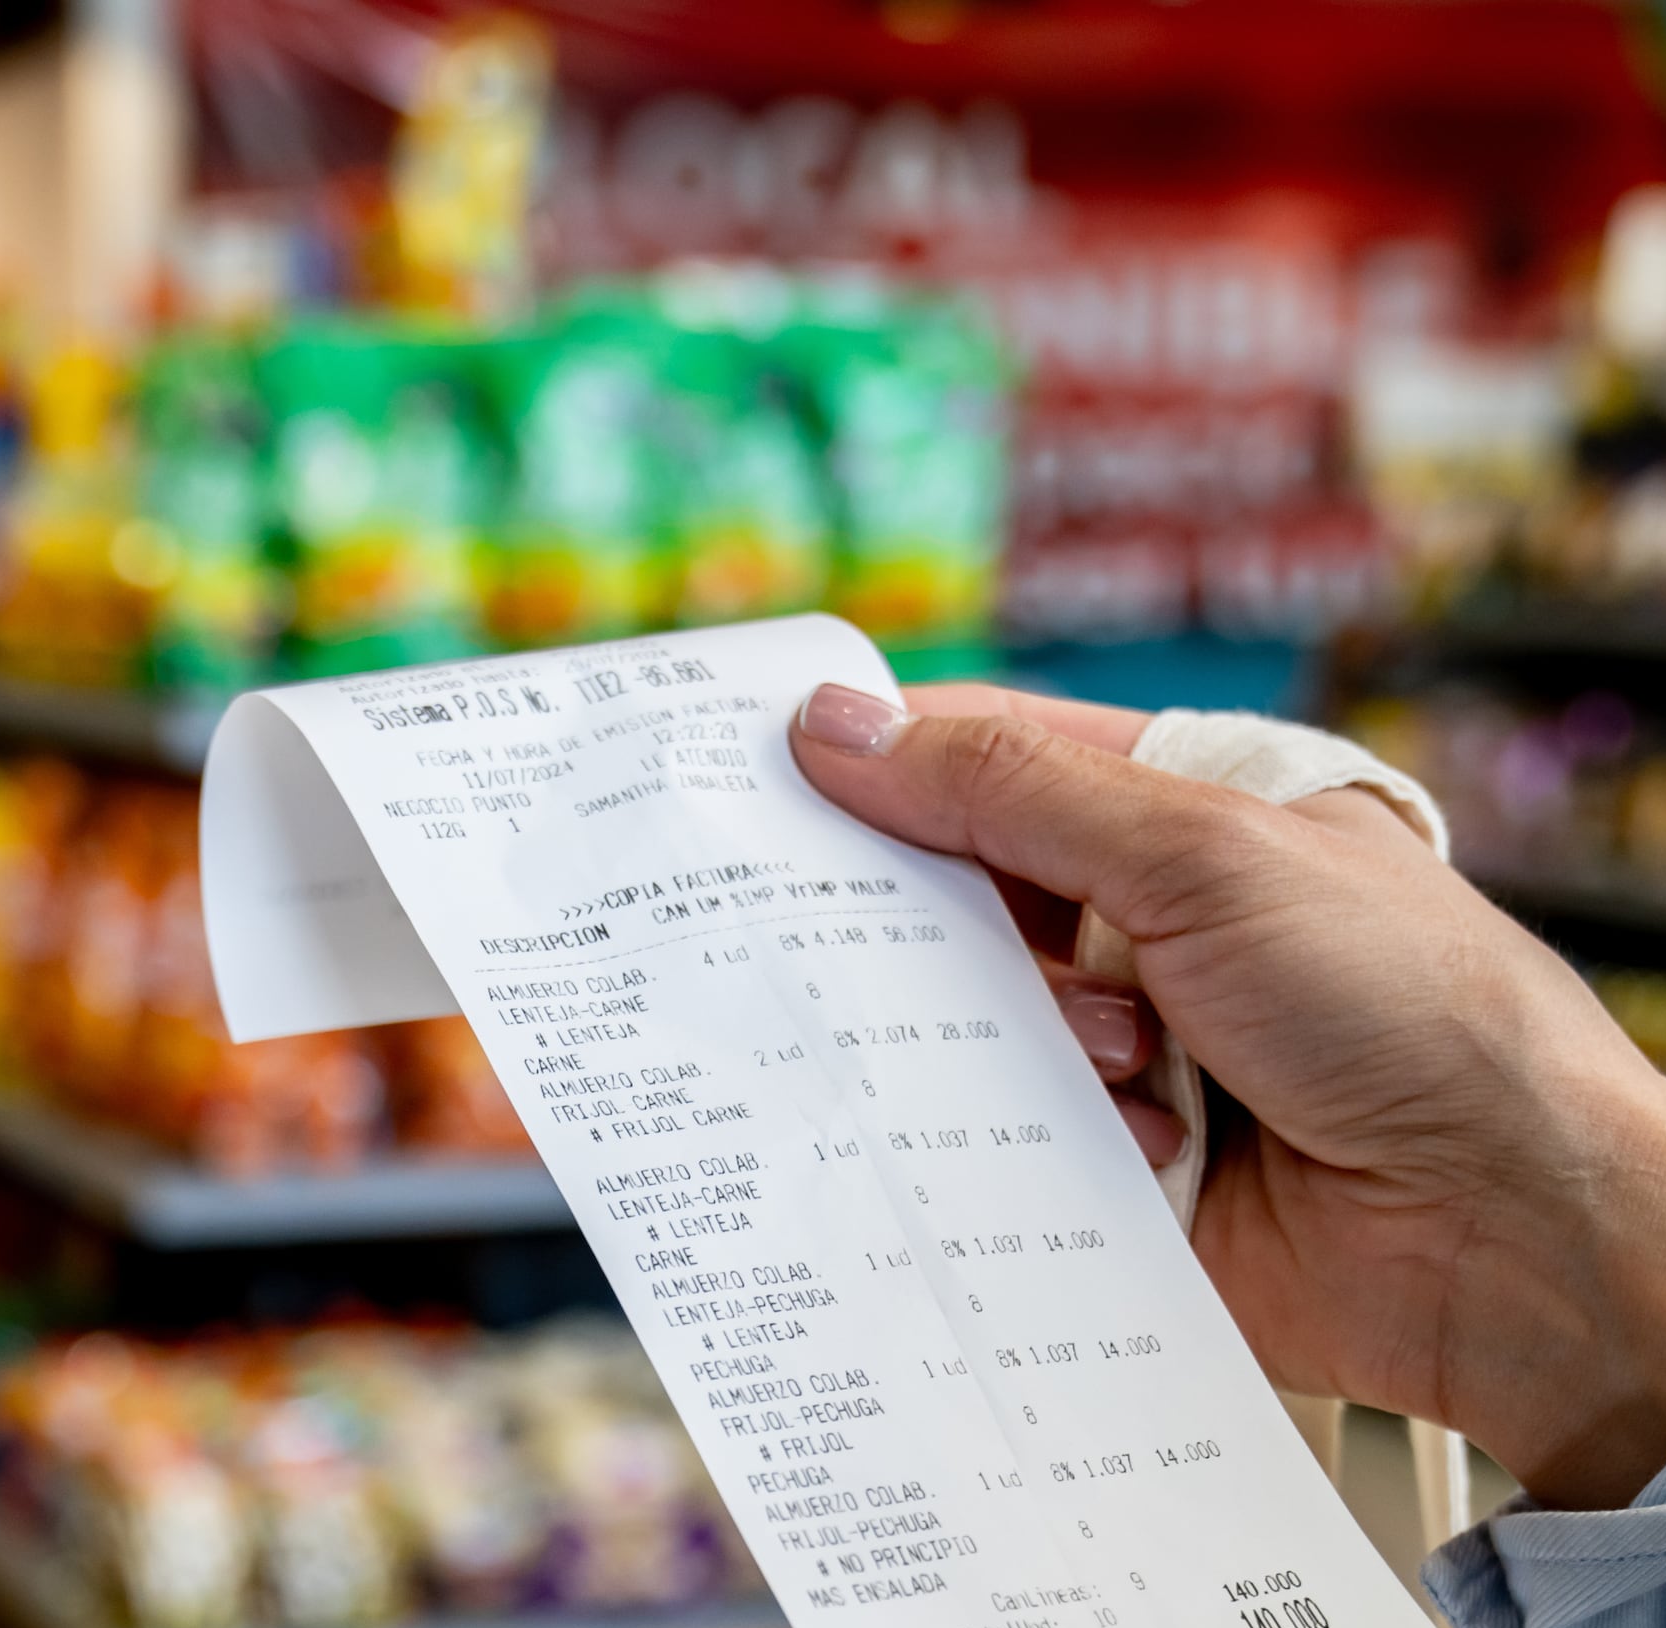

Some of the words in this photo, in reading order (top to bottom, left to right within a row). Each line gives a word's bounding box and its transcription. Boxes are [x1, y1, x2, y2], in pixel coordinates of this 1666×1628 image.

[350, 680, 463, 705] Autorizado
[363, 702, 454, 731] Sistema
[452, 687, 519, 720] P.O.S
[519, 685, 560, 713] No.
[416, 747, 475, 768] FECHA
[485, 747, 495, 762] Y
[504, 741, 551, 761] HORA
[558, 735, 584, 753] DE
[592, 709, 675, 743] EMISION
[683, 697, 769, 717] FACTURA:
[463, 760, 574, 789] 11/07/2024
[653, 721, 739, 745] 12:22:29
[383, 796, 465, 819] NEGOCIO
[473, 792, 531, 813] PUNTO
[640, 753, 667, 773] LE
[676, 749, 749, 767] ATENDIO
[509, 818, 521, 833] 1
[574, 778, 669, 818] SAMANTHA
[678, 774, 760, 793] ZABALETA
[481, 922, 611, 955] DESCRIPCION
[651, 902, 691, 924] CAN
[696, 896, 722, 915] UM
[846, 879, 901, 896] VALOR
[486, 979, 579, 1002] ALMUERZO
[585, 968, 657, 995] COLAB.
[703, 951, 715, 968] 4
[779, 933, 805, 952] 8%
[814, 927, 867, 946] 4.148
[498, 994, 650, 1026] LENTEJA-CARNE
[556, 1022, 641, 1047] LENTEJA
[524, 1053, 585, 1075] CARNE
[539, 1071, 633, 1100] ALMUERZO
[640, 1062, 712, 1086] COLAB.
[753, 1050, 769, 1067] 2
[833, 1031, 860, 1048] 8%
[866, 1025, 920, 1045] 2.074
[937, 1021, 999, 1040] 28.000
[612, 1115, 685, 1140] FRIJOL
[692, 1102, 753, 1127] CARNE
[596, 1164, 691, 1195] ALMUERZO
[699, 1151, 769, 1178] COLAB.
[813, 1141, 825, 1161] 1
[888, 1132, 913, 1150] 8%
[920, 1130, 969, 1149] 1.037
[989, 1124, 1050, 1146] 14.000
[607, 1180, 763, 1221] LENTEJA-CARNE
[669, 1211, 753, 1239] LENTEJA
[635, 1247, 699, 1273] CARNE
[652, 1270, 745, 1300] ALMUERZO
[752, 1262, 822, 1286] COLAB.
[865, 1252, 877, 1271] 1
[941, 1240, 966, 1259] 8%
[974, 1235, 1023, 1256] 1.037
[1043, 1229, 1105, 1252] 14.000
[663, 1288, 839, 1328] LENTEJA-PECHUGA
[723, 1320, 808, 1349] LENTEJA
[690, 1354, 777, 1382] PECHUGA
[707, 1378, 803, 1410] ALMUERZO
[809, 1369, 880, 1394] COLAB.
[923, 1360, 934, 1379] 1
[996, 1348, 1022, 1369] 8%
[1030, 1343, 1080, 1365] 1.037
[1099, 1335, 1161, 1360] 14.000
[720, 1397, 885, 1438] FRIJOL-PECHUGA
[781, 1431, 854, 1460] FRIJOL
[747, 1466, 834, 1495] PECHUGA
[765, 1492, 859, 1523] ALMUERZO
[865, 1480, 936, 1508] COLAB.
[978, 1471, 991, 1490] 1
[1050, 1461, 1075, 1483] 8%
[1083, 1453, 1134, 1479] 1.037
[1155, 1440, 1221, 1468] 14.000
[778, 1511, 943, 1551] FRIJOL-PECHUGA
[837, 1552, 865, 1574] NO
[871, 1534, 978, 1570] PRINCIPIO
[807, 1587, 845, 1609] MAS
[852, 1572, 949, 1603] ENSALADA
[1130, 1571, 1145, 1591] 9
[1222, 1570, 1301, 1602] 140.000
